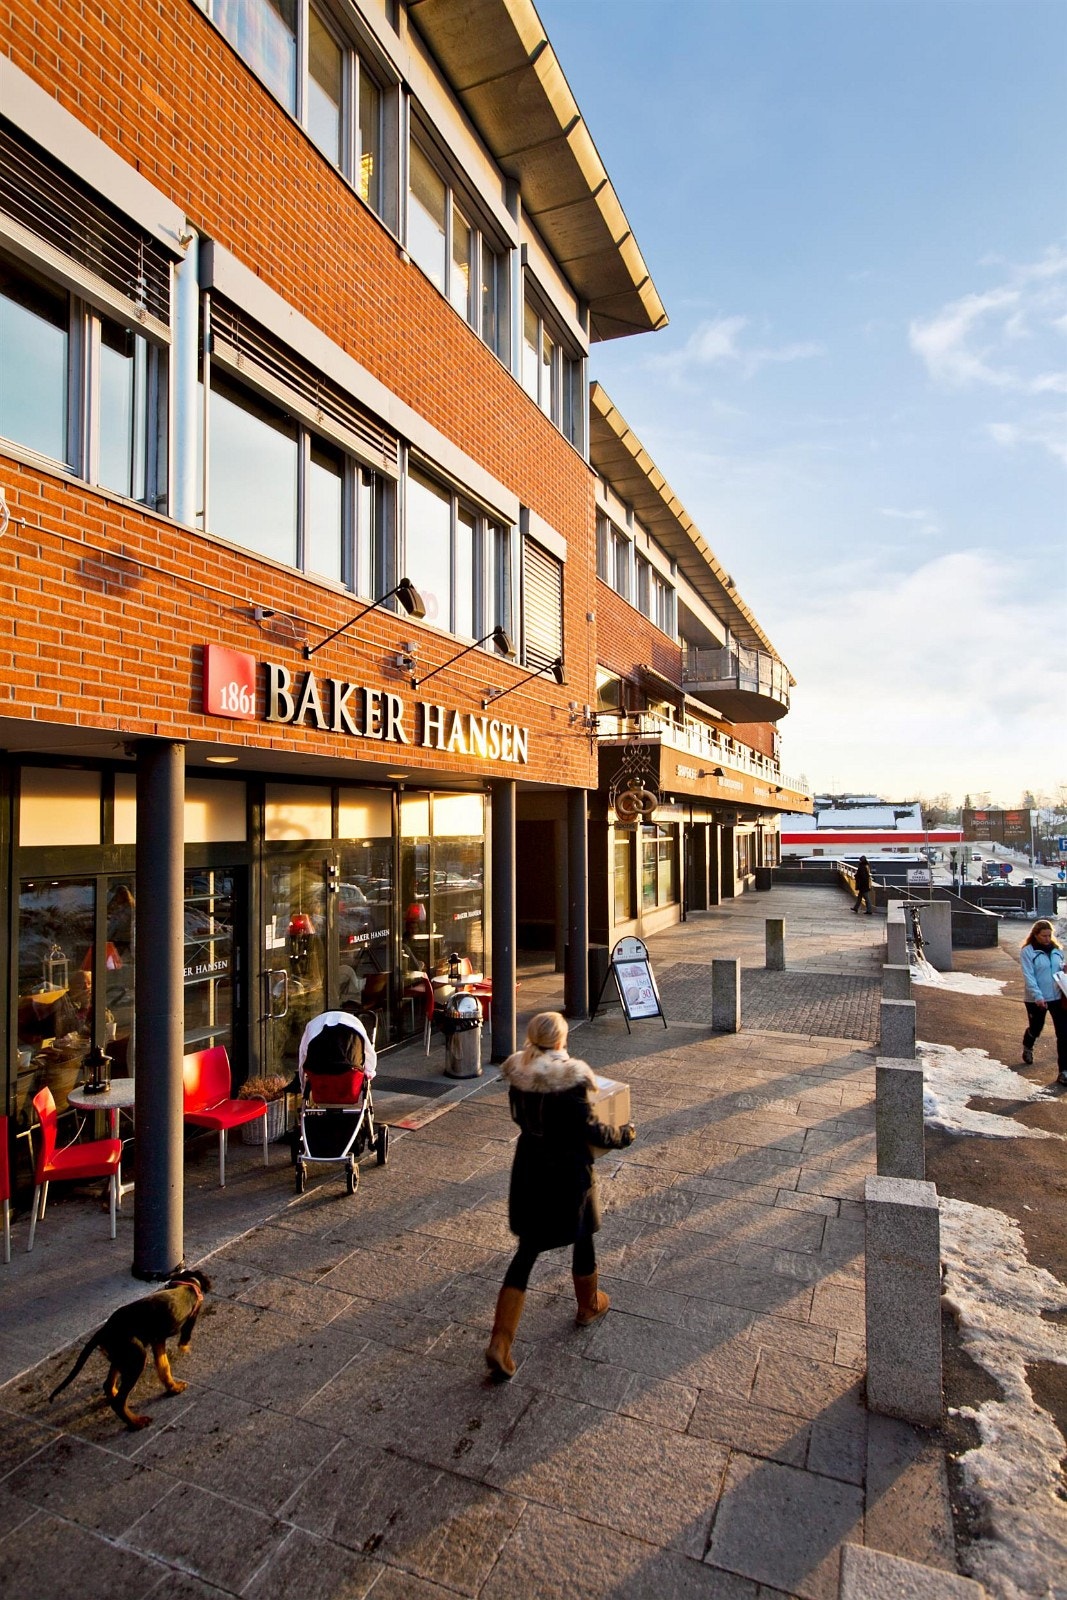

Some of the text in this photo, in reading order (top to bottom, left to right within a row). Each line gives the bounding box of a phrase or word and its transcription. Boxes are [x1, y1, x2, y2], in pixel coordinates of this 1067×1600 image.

[220, 682, 255, 715] 1861
[266, 662, 529, 764] BAKER HANSEN
[353, 933, 370, 943] BAKER
[370, 929, 390, 939] HANSEN
[195, 960, 228, 975] HANSEN
[641, 988, 651, 999] 30
